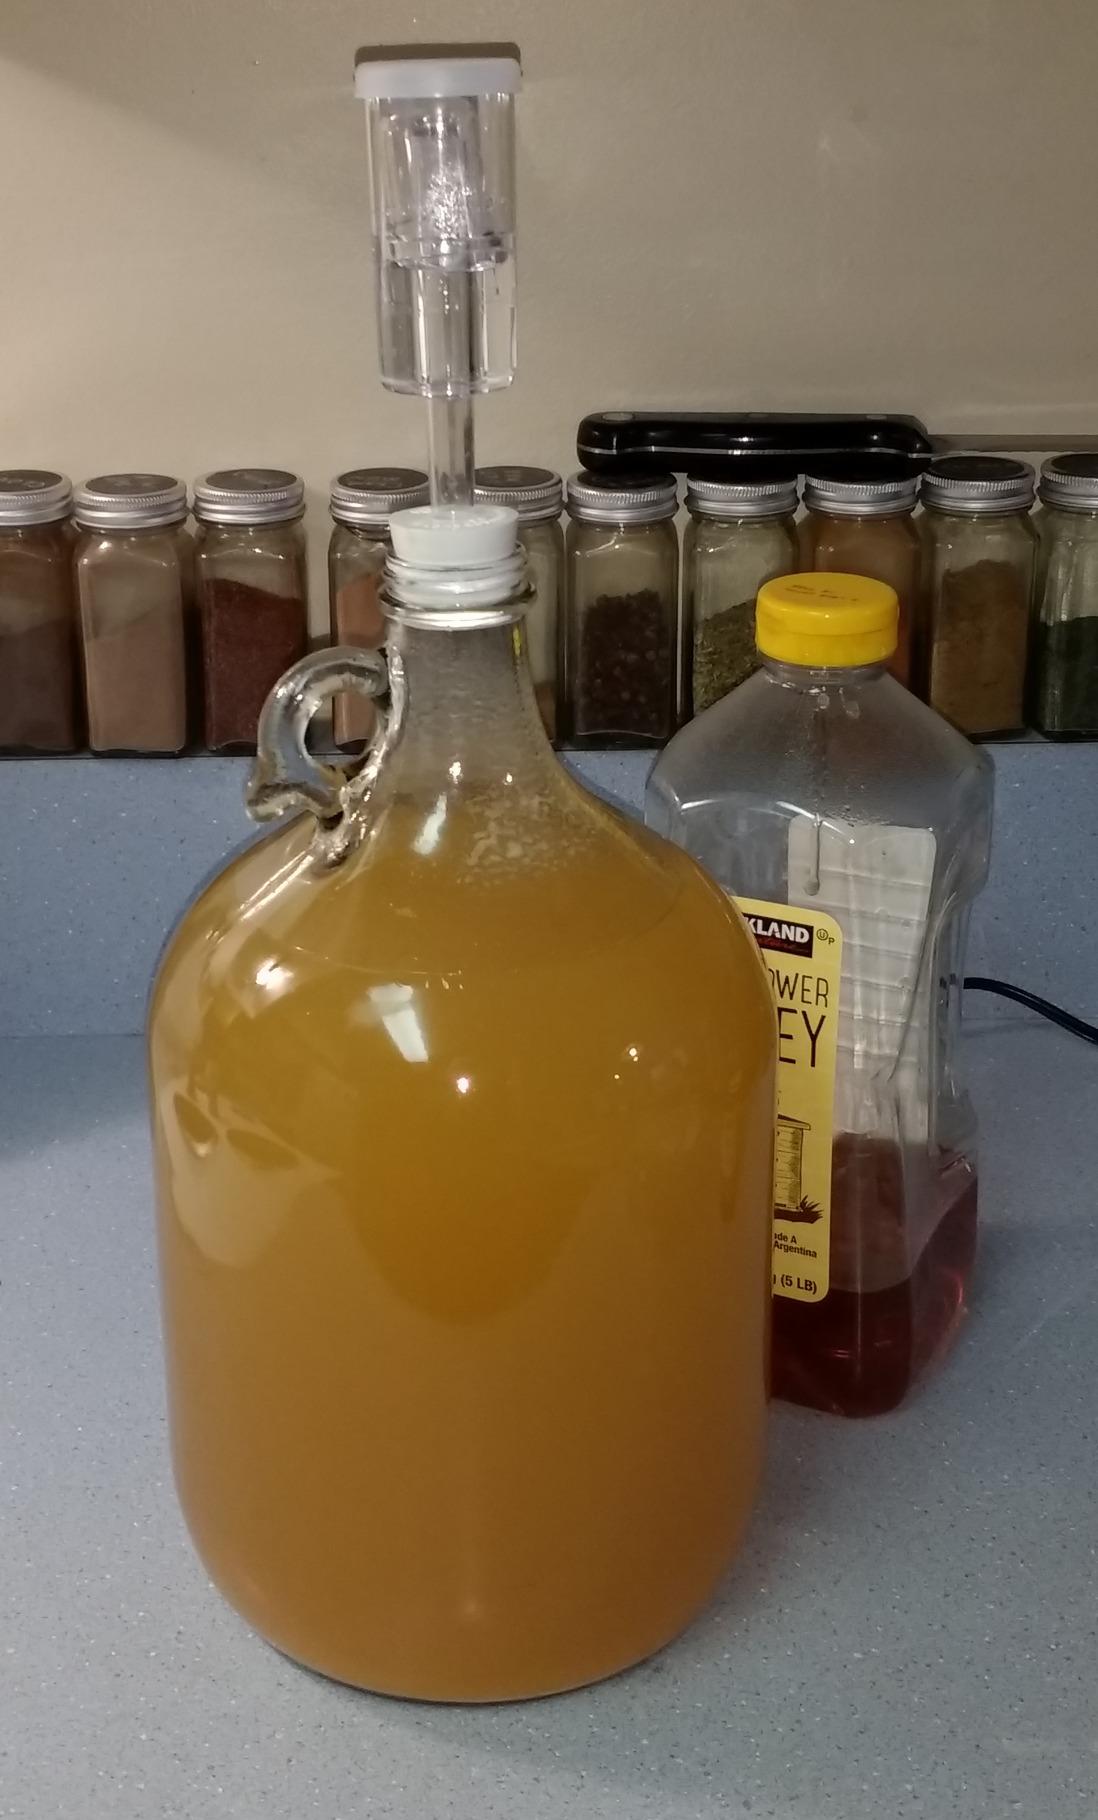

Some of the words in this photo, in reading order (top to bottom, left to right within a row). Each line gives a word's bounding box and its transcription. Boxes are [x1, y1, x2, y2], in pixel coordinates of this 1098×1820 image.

[777, 1006, 826, 1068] EY
[773, 1240, 817, 1258] Argentina
[790, 1235, 798, 1244] A
[780, 1273, 793, 1288] (5
[796, 1277, 817, 1295] LB)
